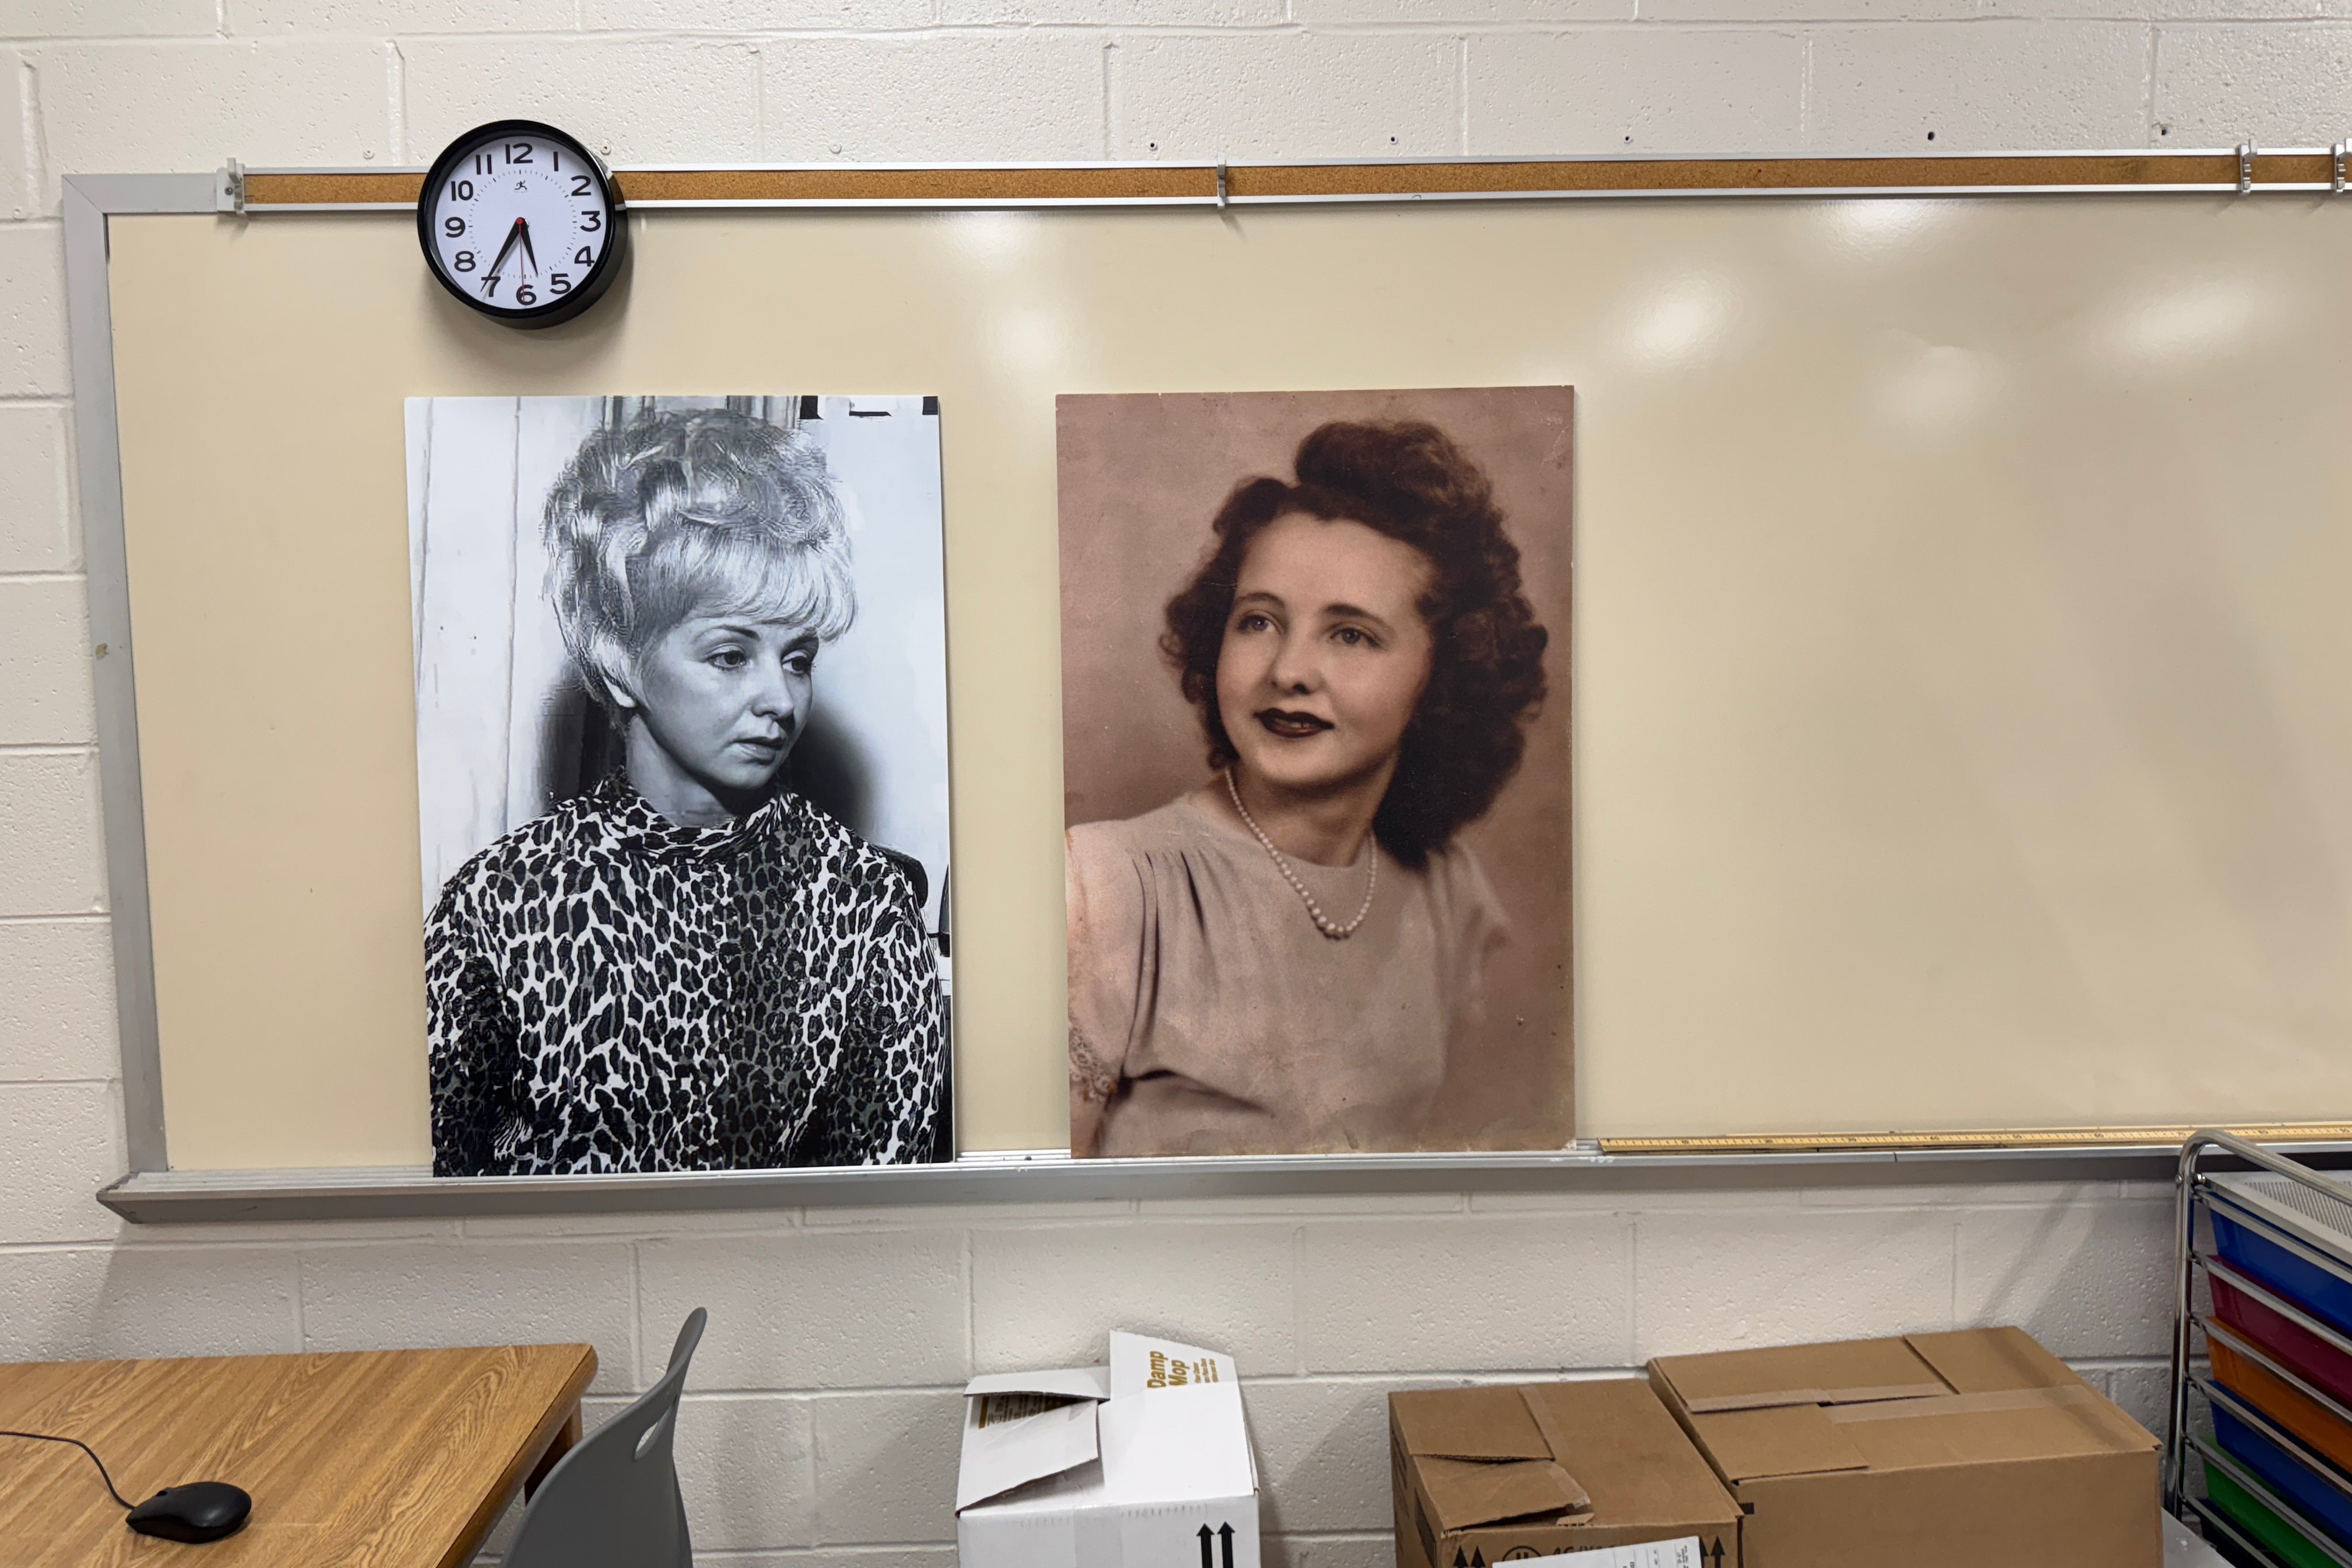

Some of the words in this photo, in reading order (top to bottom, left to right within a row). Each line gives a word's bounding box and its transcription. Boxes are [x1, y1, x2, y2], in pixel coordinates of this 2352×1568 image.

[505, 143, 533, 164] 12
[553, 151, 559, 172] 1
[475, 154, 492, 175] 11
[451, 180, 474, 201] 10
[570, 175, 592, 196] 2
[444, 216, 466, 238] 9
[580, 211, 601, 232] 3
[454, 251, 476, 272] 8
[574, 246, 595, 267] 4
[481, 276, 501, 298] 7
[549, 273, 572, 295] 5
[516, 285, 537, 306] 6
[1147, 1350, 1168, 1388] Damp
[1168, 1359, 1190, 1386] Mop
